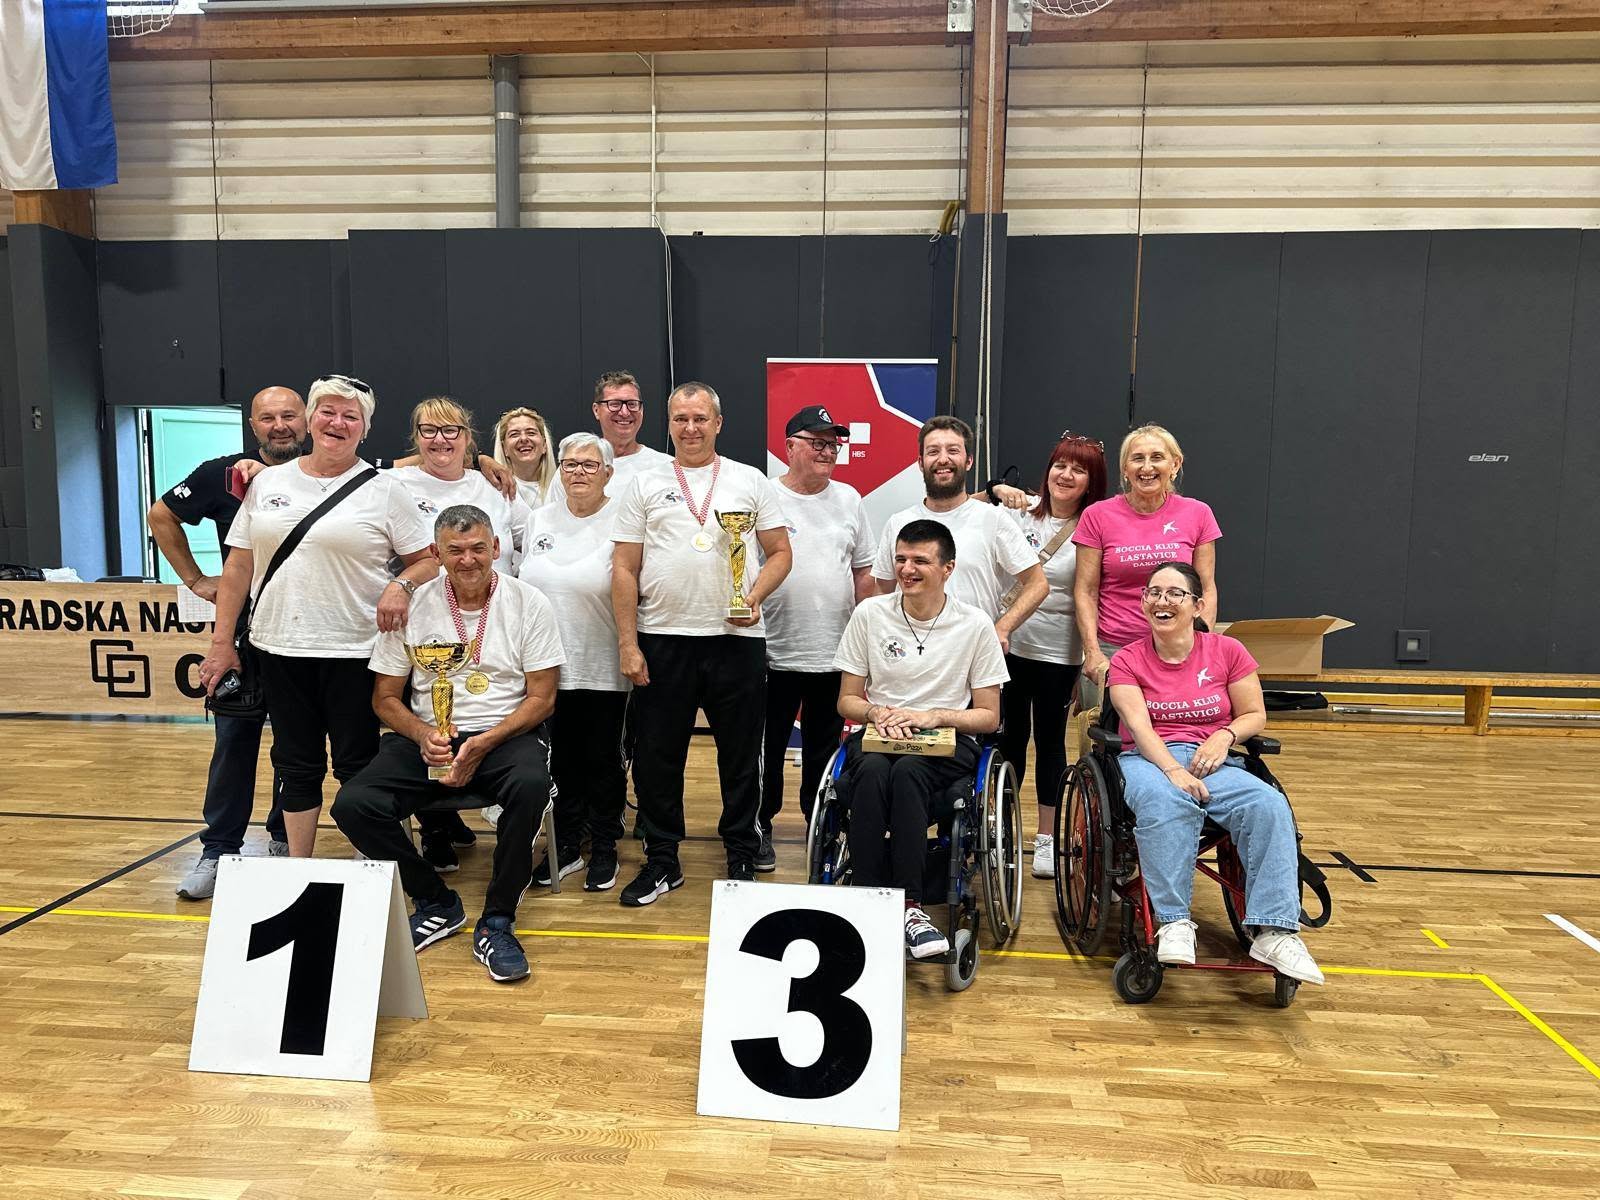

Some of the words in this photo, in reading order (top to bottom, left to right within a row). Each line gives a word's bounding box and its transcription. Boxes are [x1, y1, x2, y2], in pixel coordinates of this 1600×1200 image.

[1468, 453, 1509, 462] elan
[1115, 544, 1152, 554] BOCCIA
[1155, 542, 1181, 551] KLUB
[1120, 551, 1178, 562] LASTAVICE
[0, 599, 130, 632] RADSKA
[1146, 700, 1190, 710] BOCCIA
[1192, 694, 1221, 708] KLUB
[1152, 706, 1221, 720] LASTAVICE
[246, 881, 345, 1057] 1
[730, 908, 873, 1100] 3
